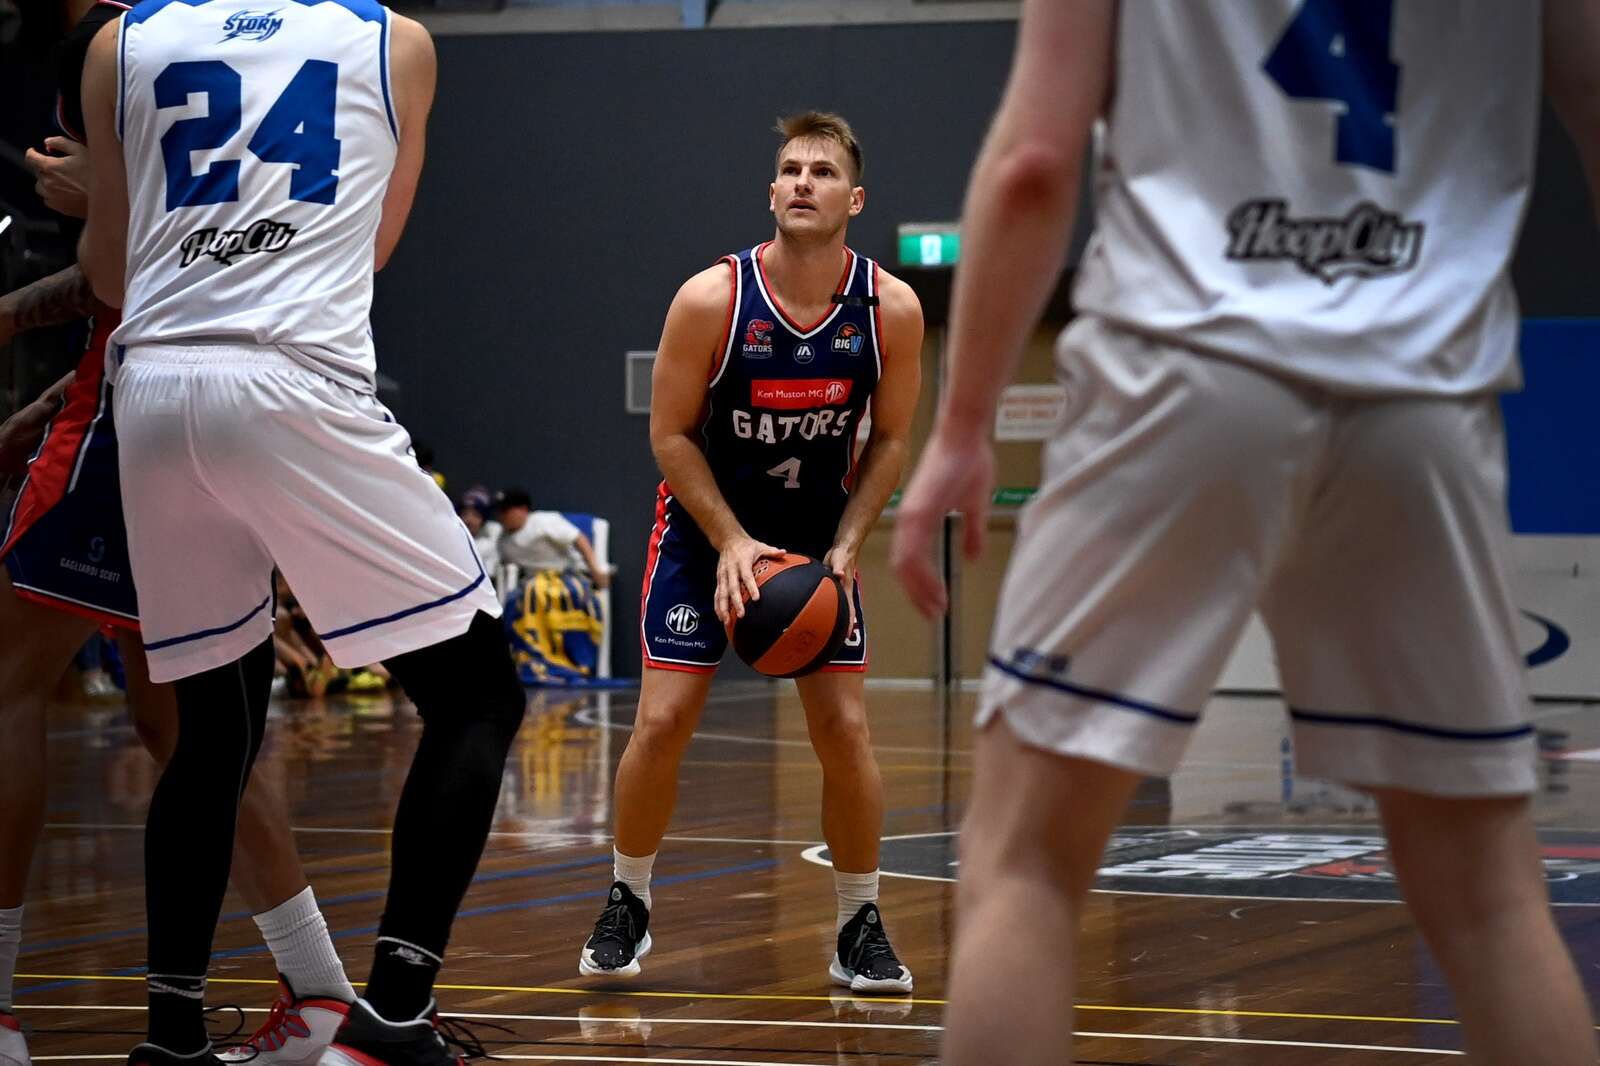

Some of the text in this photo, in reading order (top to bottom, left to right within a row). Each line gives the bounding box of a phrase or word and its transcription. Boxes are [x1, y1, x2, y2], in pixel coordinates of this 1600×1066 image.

[222, 14, 284, 33] STORM
[1262, 0, 1404, 178] 4
[153, 59, 342, 213] 24
[743, 344, 773, 353] GATORS
[834, 338, 850, 349] BIG
[757, 389, 824, 398] Ken Muston MG
[732, 408, 853, 444] GATORS
[766, 456, 802, 489] 4
[99, 568, 120, 583] SCOTT
[667, 605, 698, 634] MG
[654, 636, 667, 644] Ken
[668, 637, 693, 647] Muston
